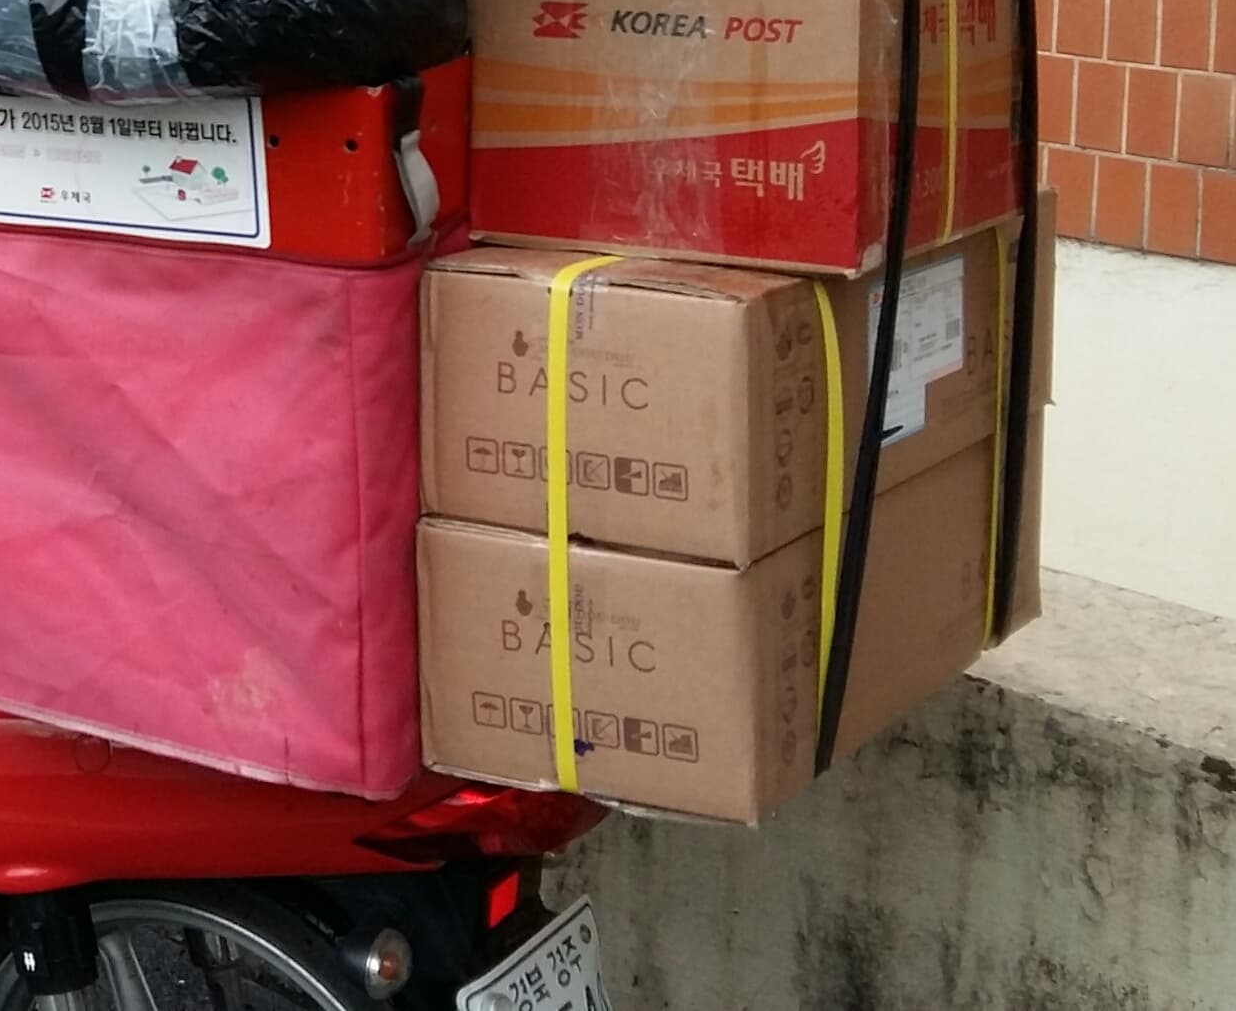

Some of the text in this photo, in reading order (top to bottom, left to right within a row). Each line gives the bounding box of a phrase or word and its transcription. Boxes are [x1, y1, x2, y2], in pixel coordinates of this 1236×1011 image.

[610, 9, 803, 44] KOREA POST
[22, 112, 75, 135] 2015년
[80, 116, 105, 136] 8월
[110, 117, 163, 140] 1일부터
[168, 120, 238, 144] 바뀝니다.
[731, 157, 805, 201] 택배
[497, 361, 649, 410] BASIC
[501, 619, 656, 673] BASIC
[509, 962, 551, 1011] 경북
[546, 935, 583, 987] 경주
